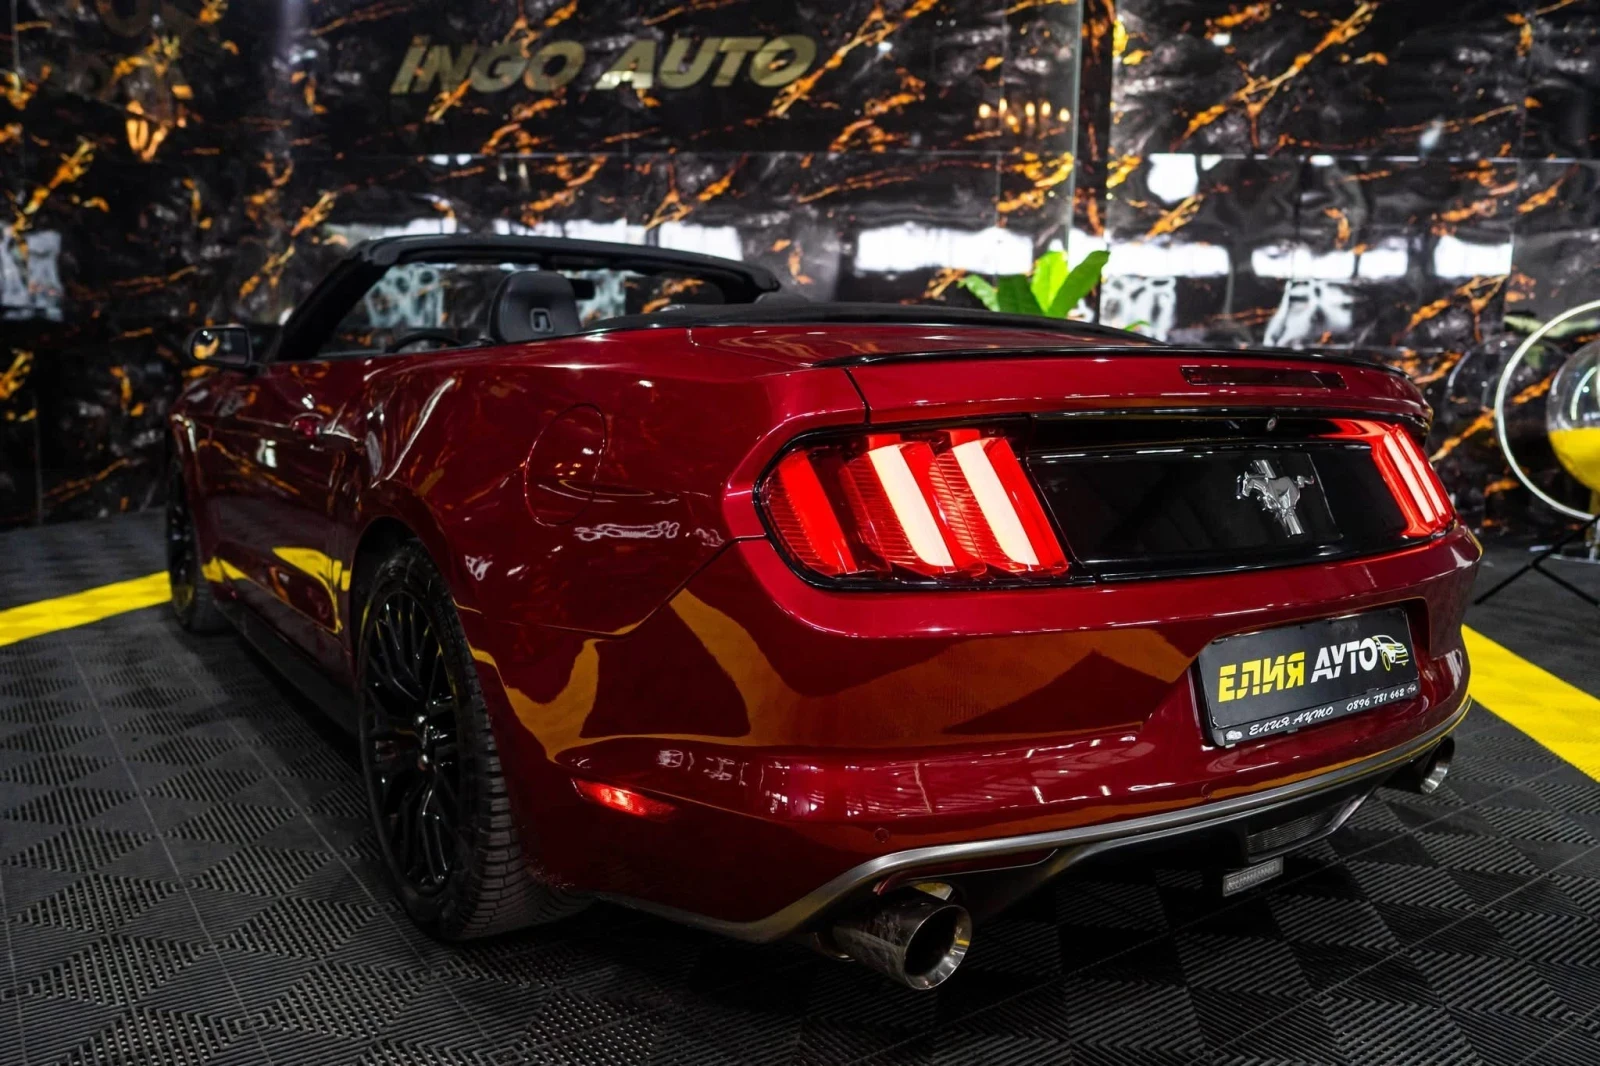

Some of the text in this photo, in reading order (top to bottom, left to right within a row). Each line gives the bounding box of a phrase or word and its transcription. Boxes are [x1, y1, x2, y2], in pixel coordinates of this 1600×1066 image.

[596, 35, 817, 89] AUTO
[1218, 637, 1378, 702] ЕЛИЯ АУТО
[1249, 716, 1290, 736] ЕЛИЯ
[1346, 697, 1370, 711] 0896
[1373, 693, 1387, 704] 781
[1389, 688, 1405, 699] 662
